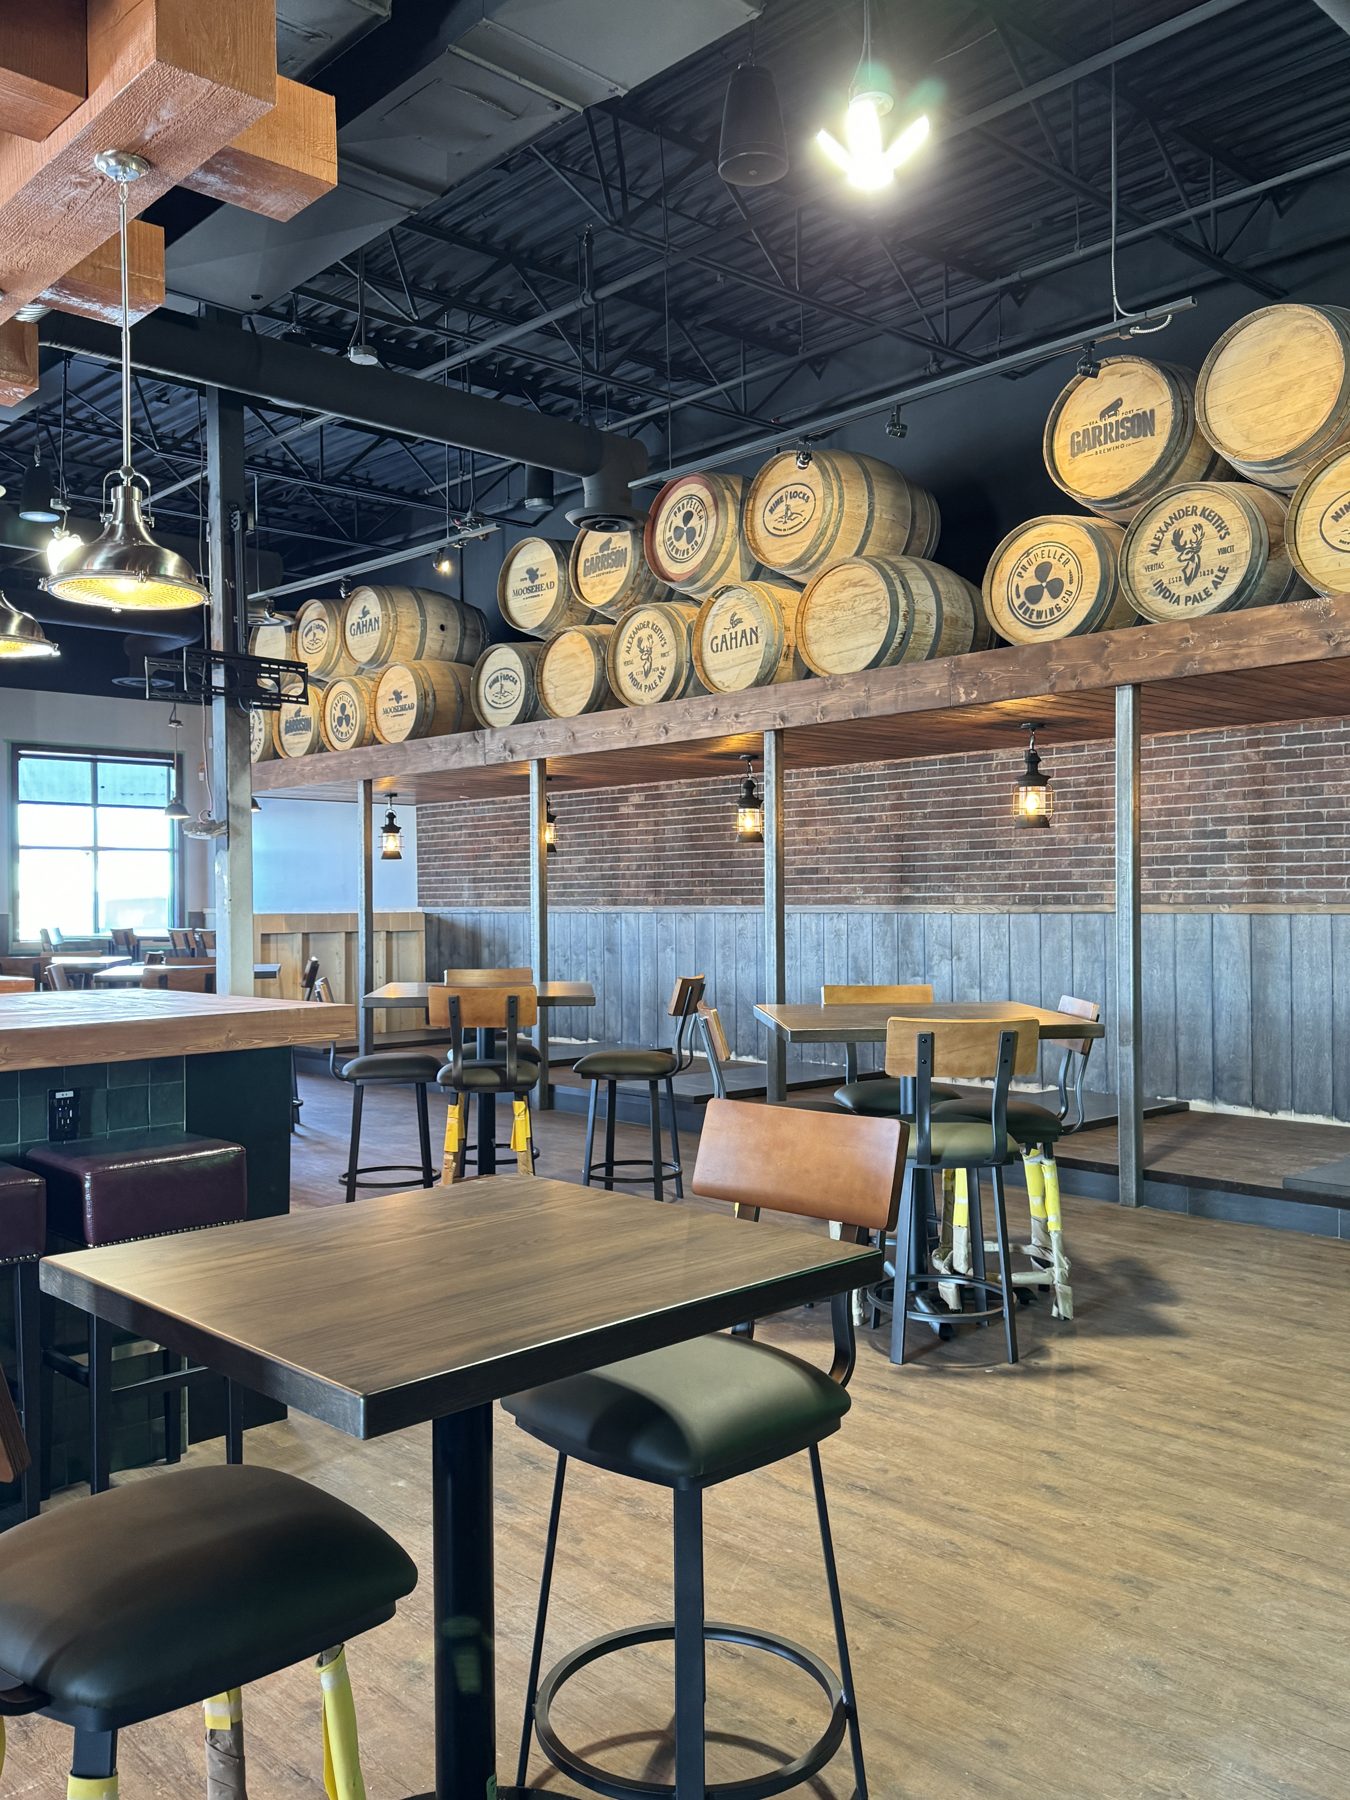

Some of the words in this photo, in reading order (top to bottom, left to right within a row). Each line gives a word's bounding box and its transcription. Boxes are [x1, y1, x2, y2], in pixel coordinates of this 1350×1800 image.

[1071, 409, 1155, 458] GARRISON
[1095, 443, 1125, 456] BREWING
[789, 490, 810, 503] LOCKS
[673, 499, 704, 522] PROPELLER
[1148, 505, 1198, 556] ALEXANDER
[1199, 506, 1231, 541] KEITH'S
[583, 546, 628, 578] GARRISON
[1016, 549, 1071, 579] PROPELLER
[1144, 562, 1165, 573] VERITAS
[511, 580, 555, 598] MOOSEHEAD
[1152, 578, 1181, 606] INDIA
[1184, 586, 1214, 606] PALE
[1211, 565, 1230, 590] ALE
[1017, 600, 1062, 620] BREWING
[350, 616, 380, 637] GAHAN
[625, 620, 651, 655] ALEXANDER
[650, 621, 667, 648] KEITH'S
[710, 626, 759, 654] GAHAN
[628, 671, 643, 692] INDIA
[643, 681, 659, 693] PALE
[657, 665, 667, 683] ALE
[383, 702, 415, 715] MOOSEHEAD
